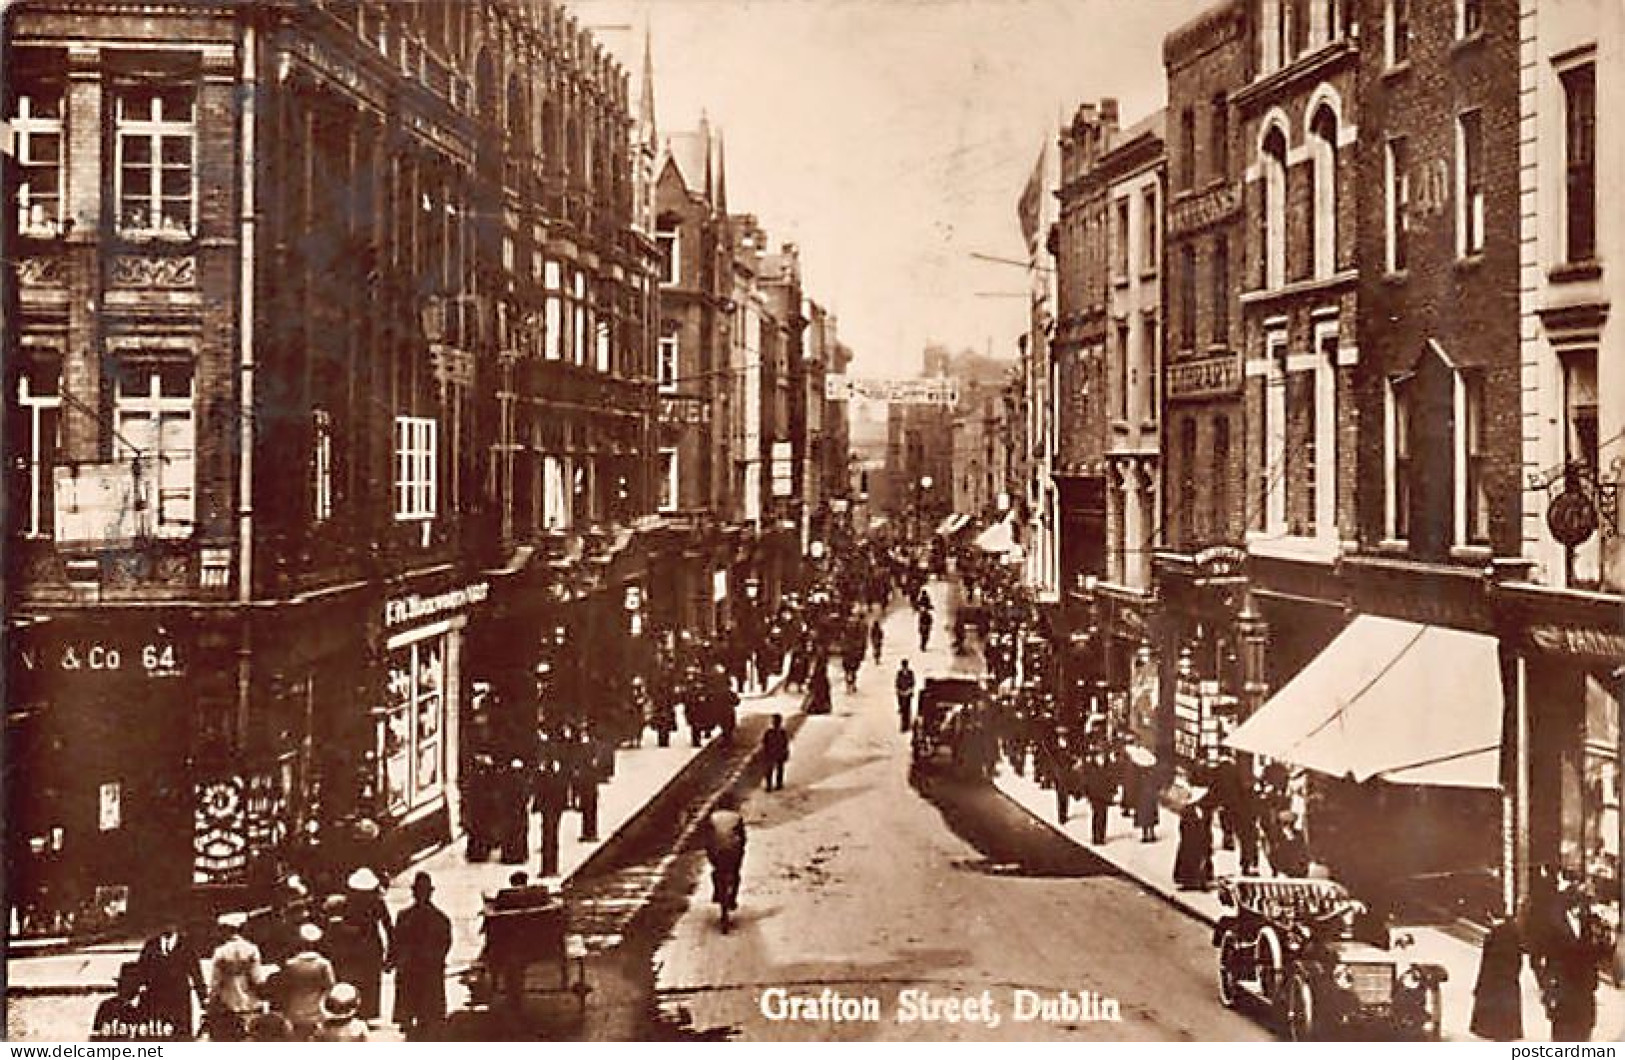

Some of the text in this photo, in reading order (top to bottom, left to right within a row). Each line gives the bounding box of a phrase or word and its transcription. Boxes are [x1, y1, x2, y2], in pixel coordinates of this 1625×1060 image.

[61, 647, 81, 669] &
[89, 646, 120, 669] Co
[142, 644, 176, 669] 64
